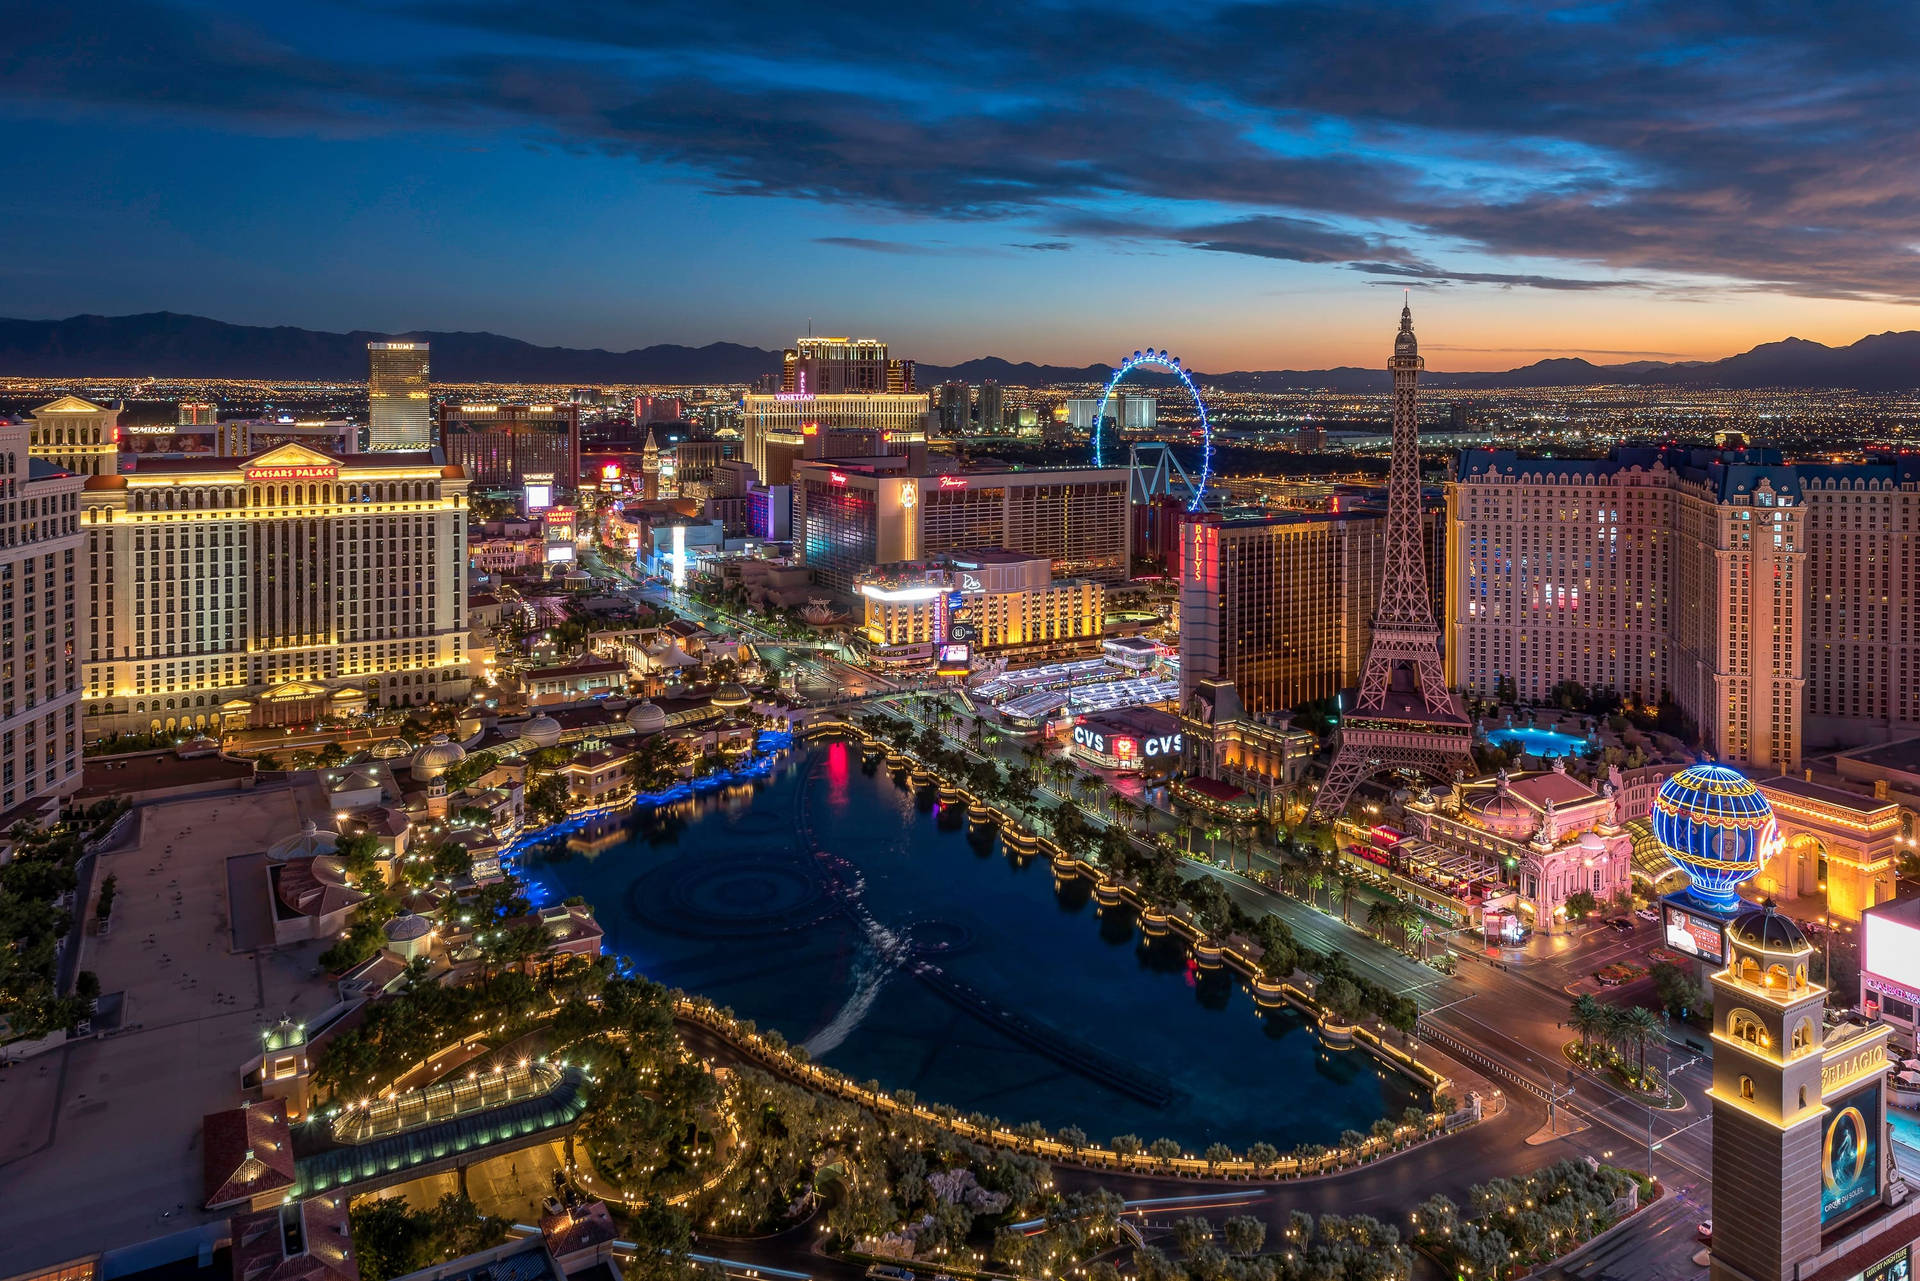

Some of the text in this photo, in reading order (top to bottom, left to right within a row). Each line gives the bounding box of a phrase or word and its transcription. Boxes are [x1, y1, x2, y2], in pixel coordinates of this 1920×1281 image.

[133, 426, 176, 434] MIRAGE
[249, 468, 335, 478] CAESARS PALACE
[1074, 726, 1104, 752] CVS
[1145, 733, 1182, 756] CVS
[1824, 1186, 1864, 1213] CIRQUE DU SOLEIL
[1883, 1247, 1908, 1267] NIGHTLIFE
